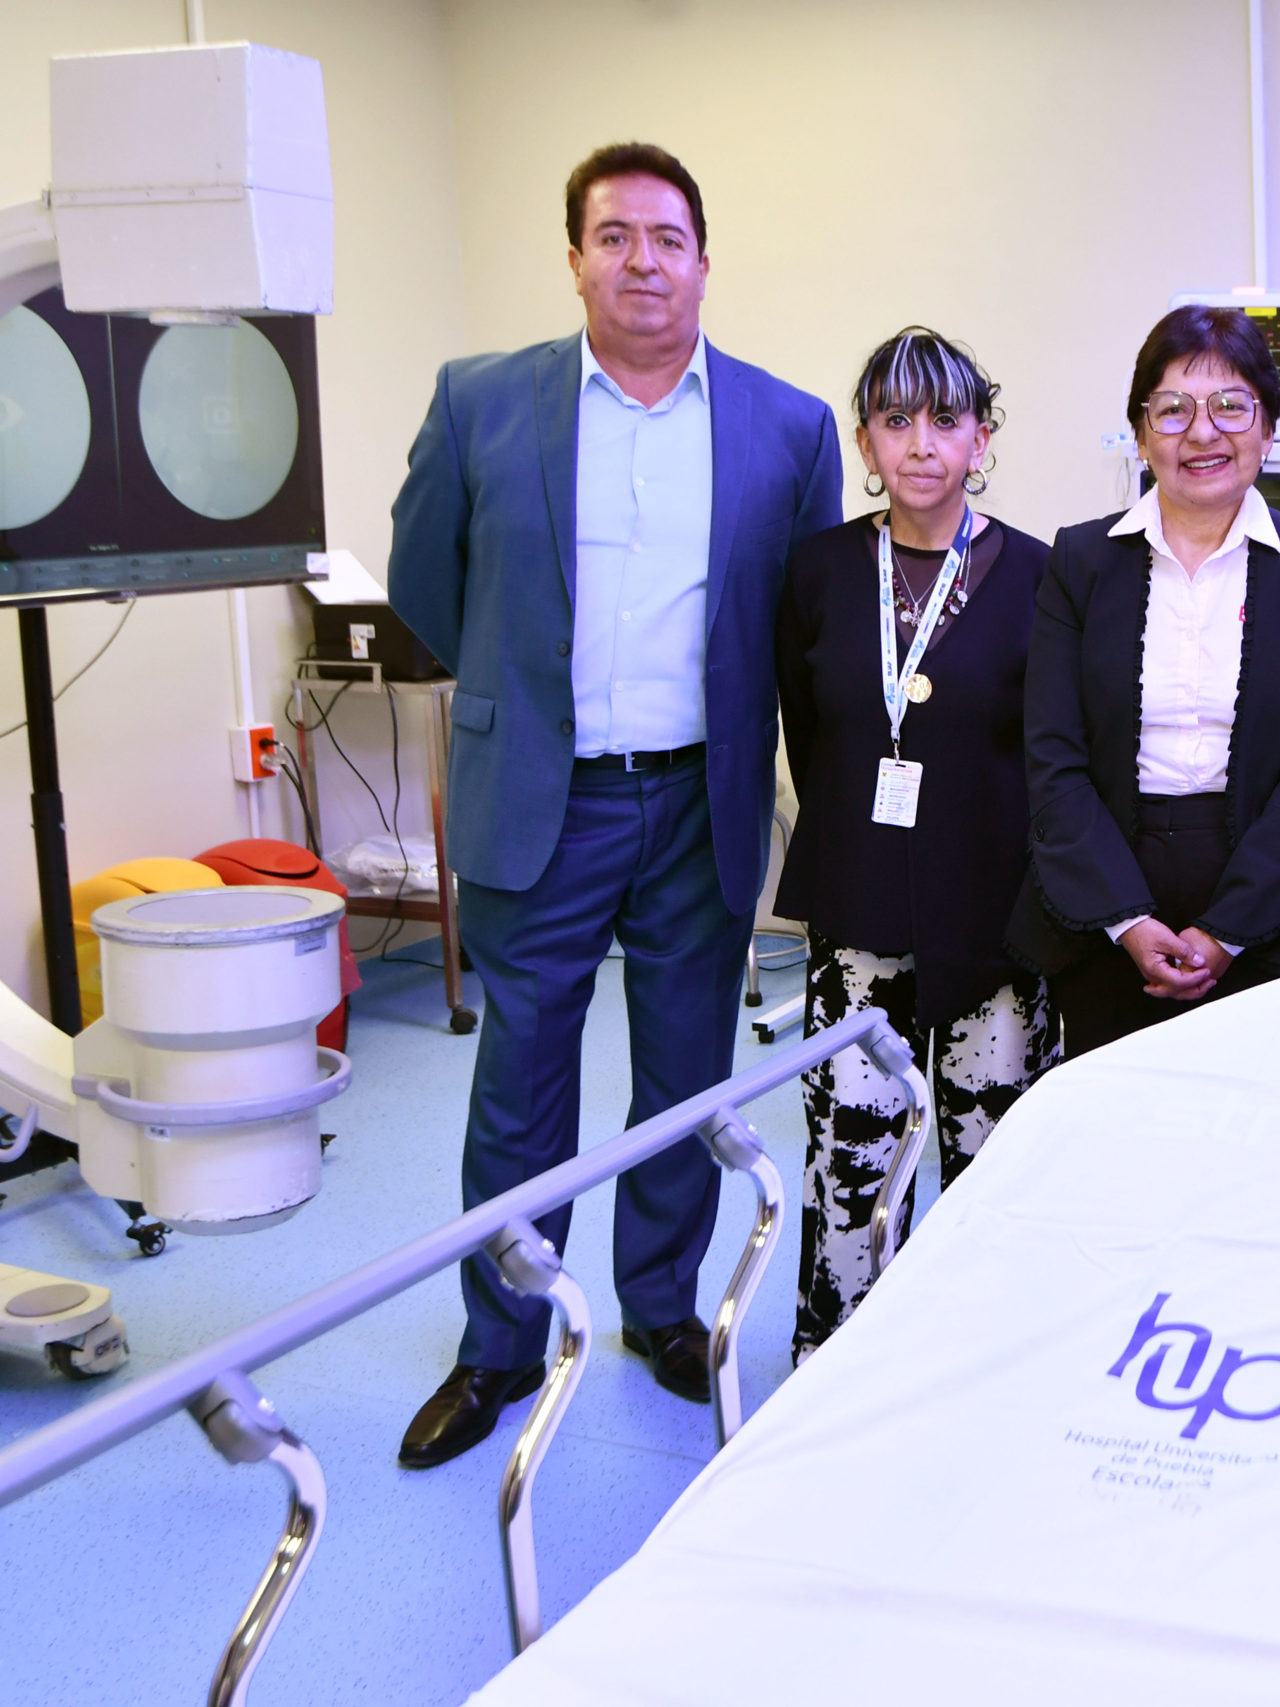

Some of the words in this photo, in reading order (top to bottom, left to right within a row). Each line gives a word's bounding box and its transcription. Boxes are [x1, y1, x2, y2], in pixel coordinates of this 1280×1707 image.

[1064, 1429, 1149, 1450] Hospital
[1111, 1451, 1138, 1465] de
[1143, 1455, 1214, 1476] Puebla
